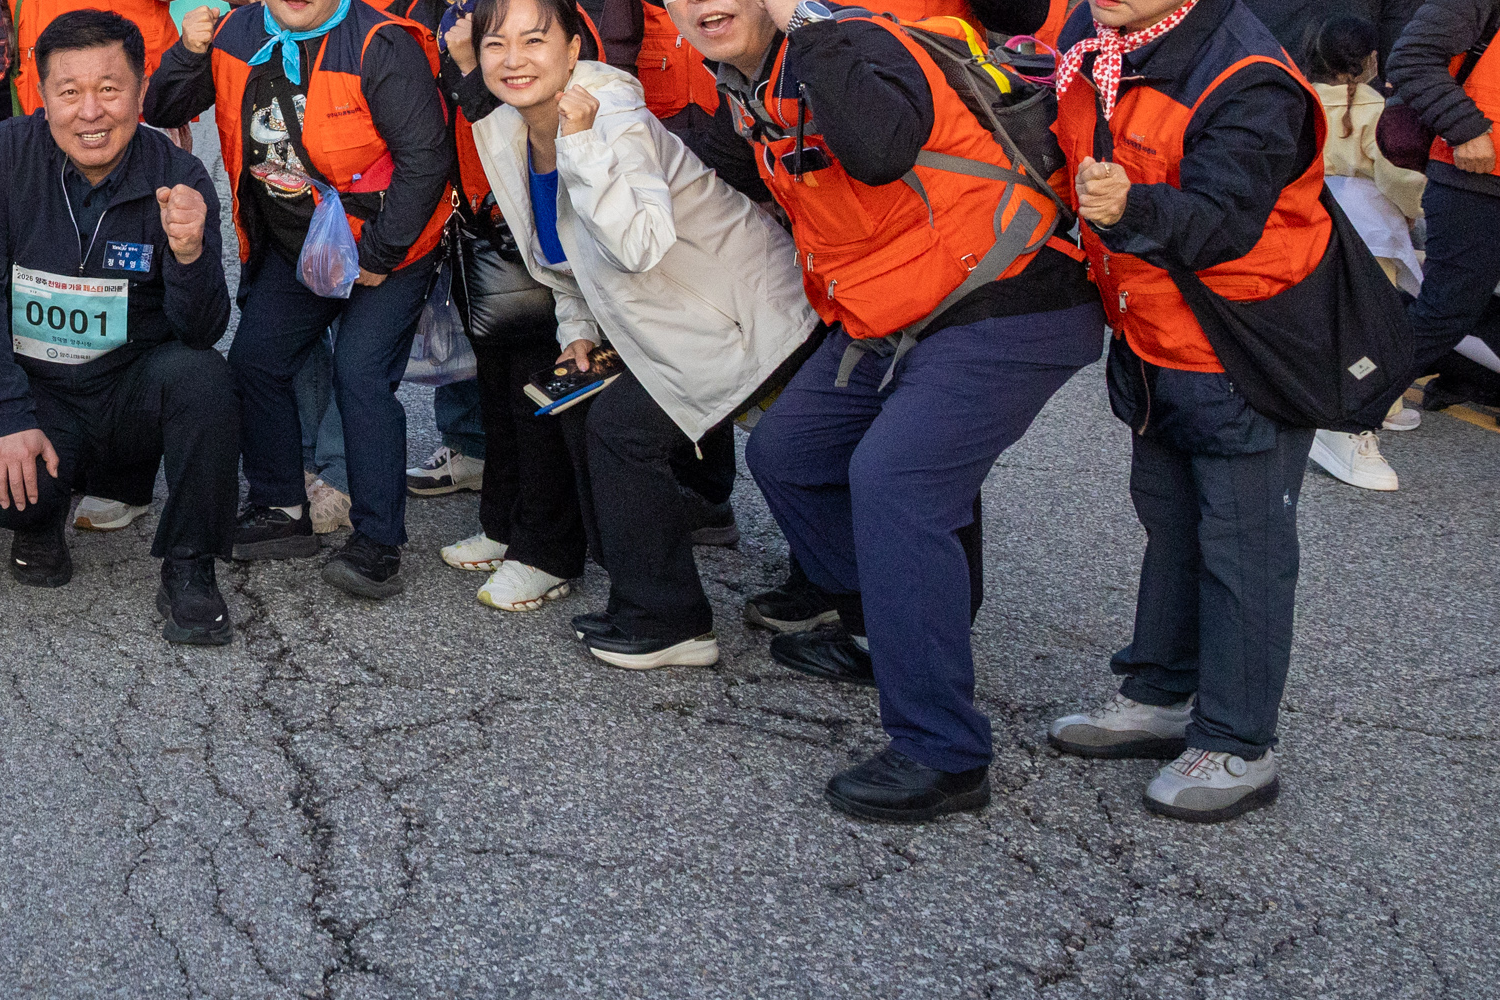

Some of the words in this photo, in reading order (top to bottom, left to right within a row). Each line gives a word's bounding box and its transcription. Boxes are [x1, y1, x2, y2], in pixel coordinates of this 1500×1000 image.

[16, 272, 34, 282] 2026
[35, 276, 48, 286] 양주
[47, 279, 68, 291] 천일홍
[68, 283, 83, 292] 가을
[82, 284, 104, 293] 페스타
[104, 285, 123, 293] 마라톤
[25, 300, 108, 337] 0001
